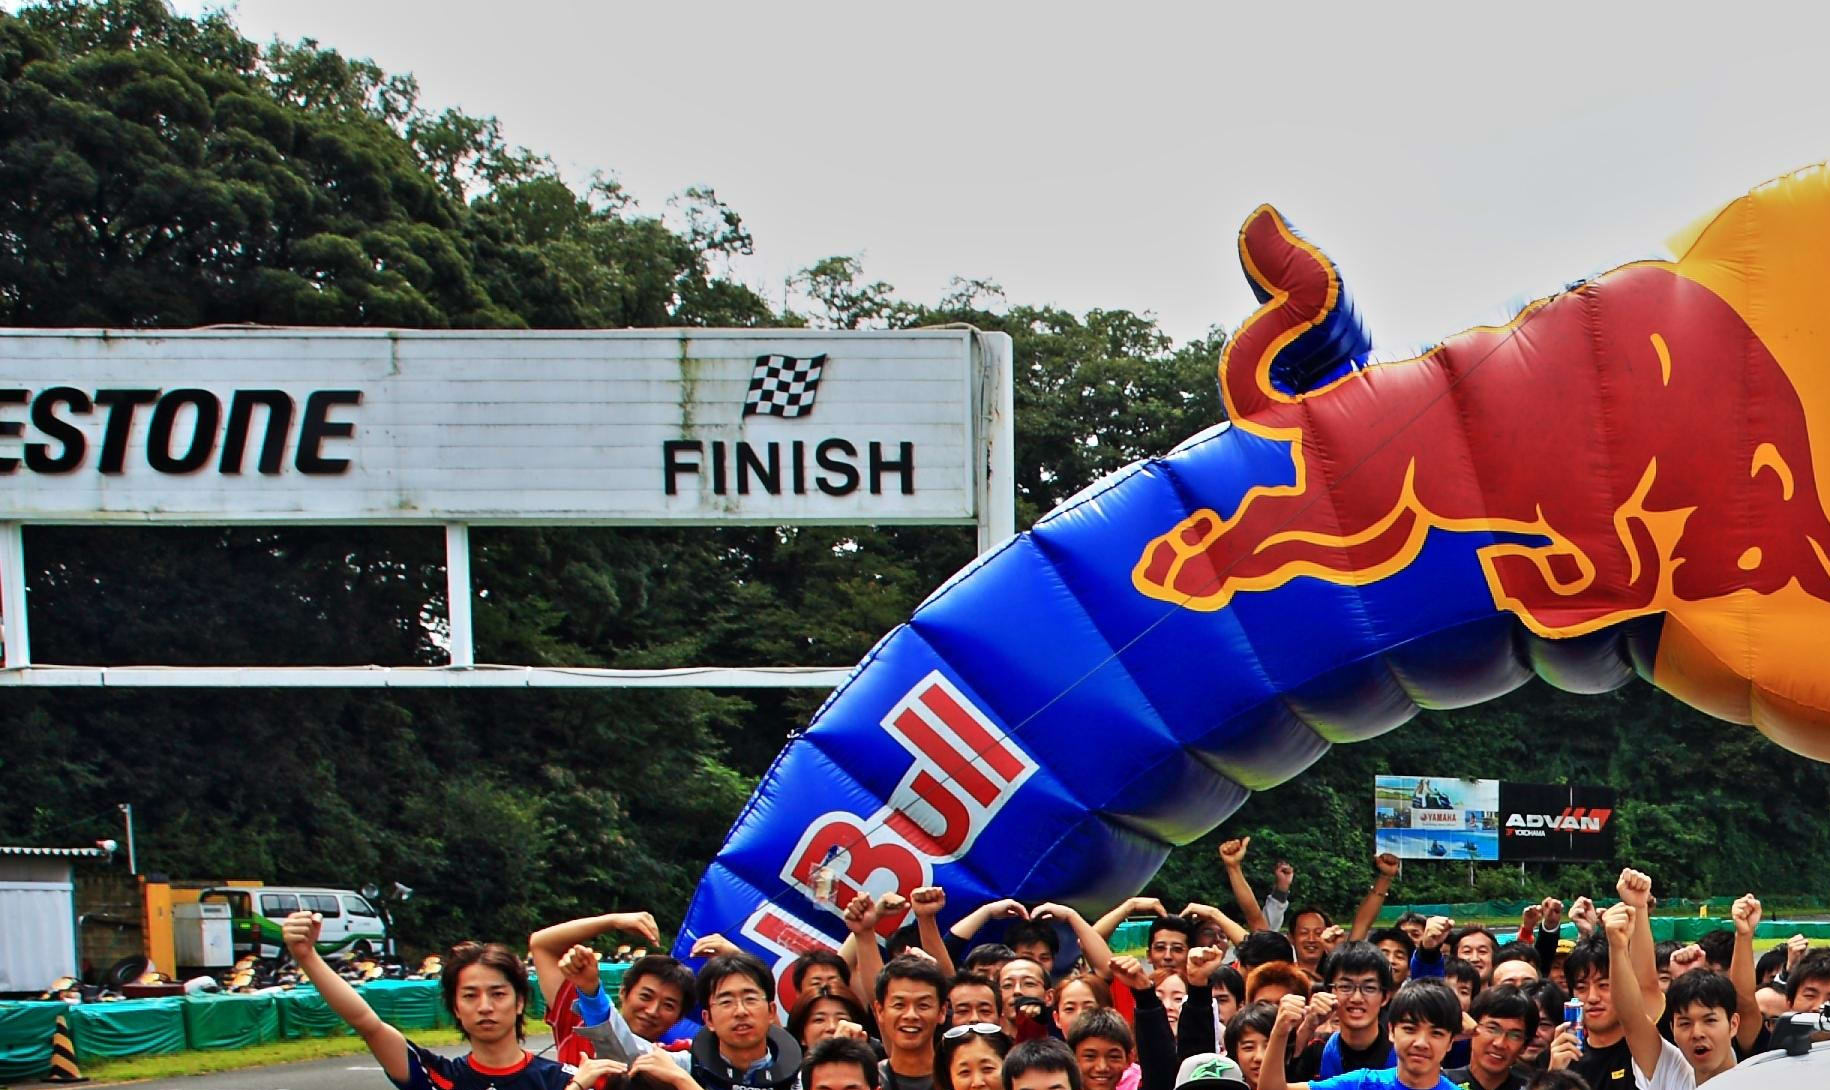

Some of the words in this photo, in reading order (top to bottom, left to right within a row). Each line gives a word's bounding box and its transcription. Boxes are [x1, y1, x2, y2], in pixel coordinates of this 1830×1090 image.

[663, 438, 915, 496] FINISH
[786, 676, 1033, 942] Bull
[1428, 813, 1457, 822] YAMAHA
[1505, 813, 1600, 830] ADVAN
